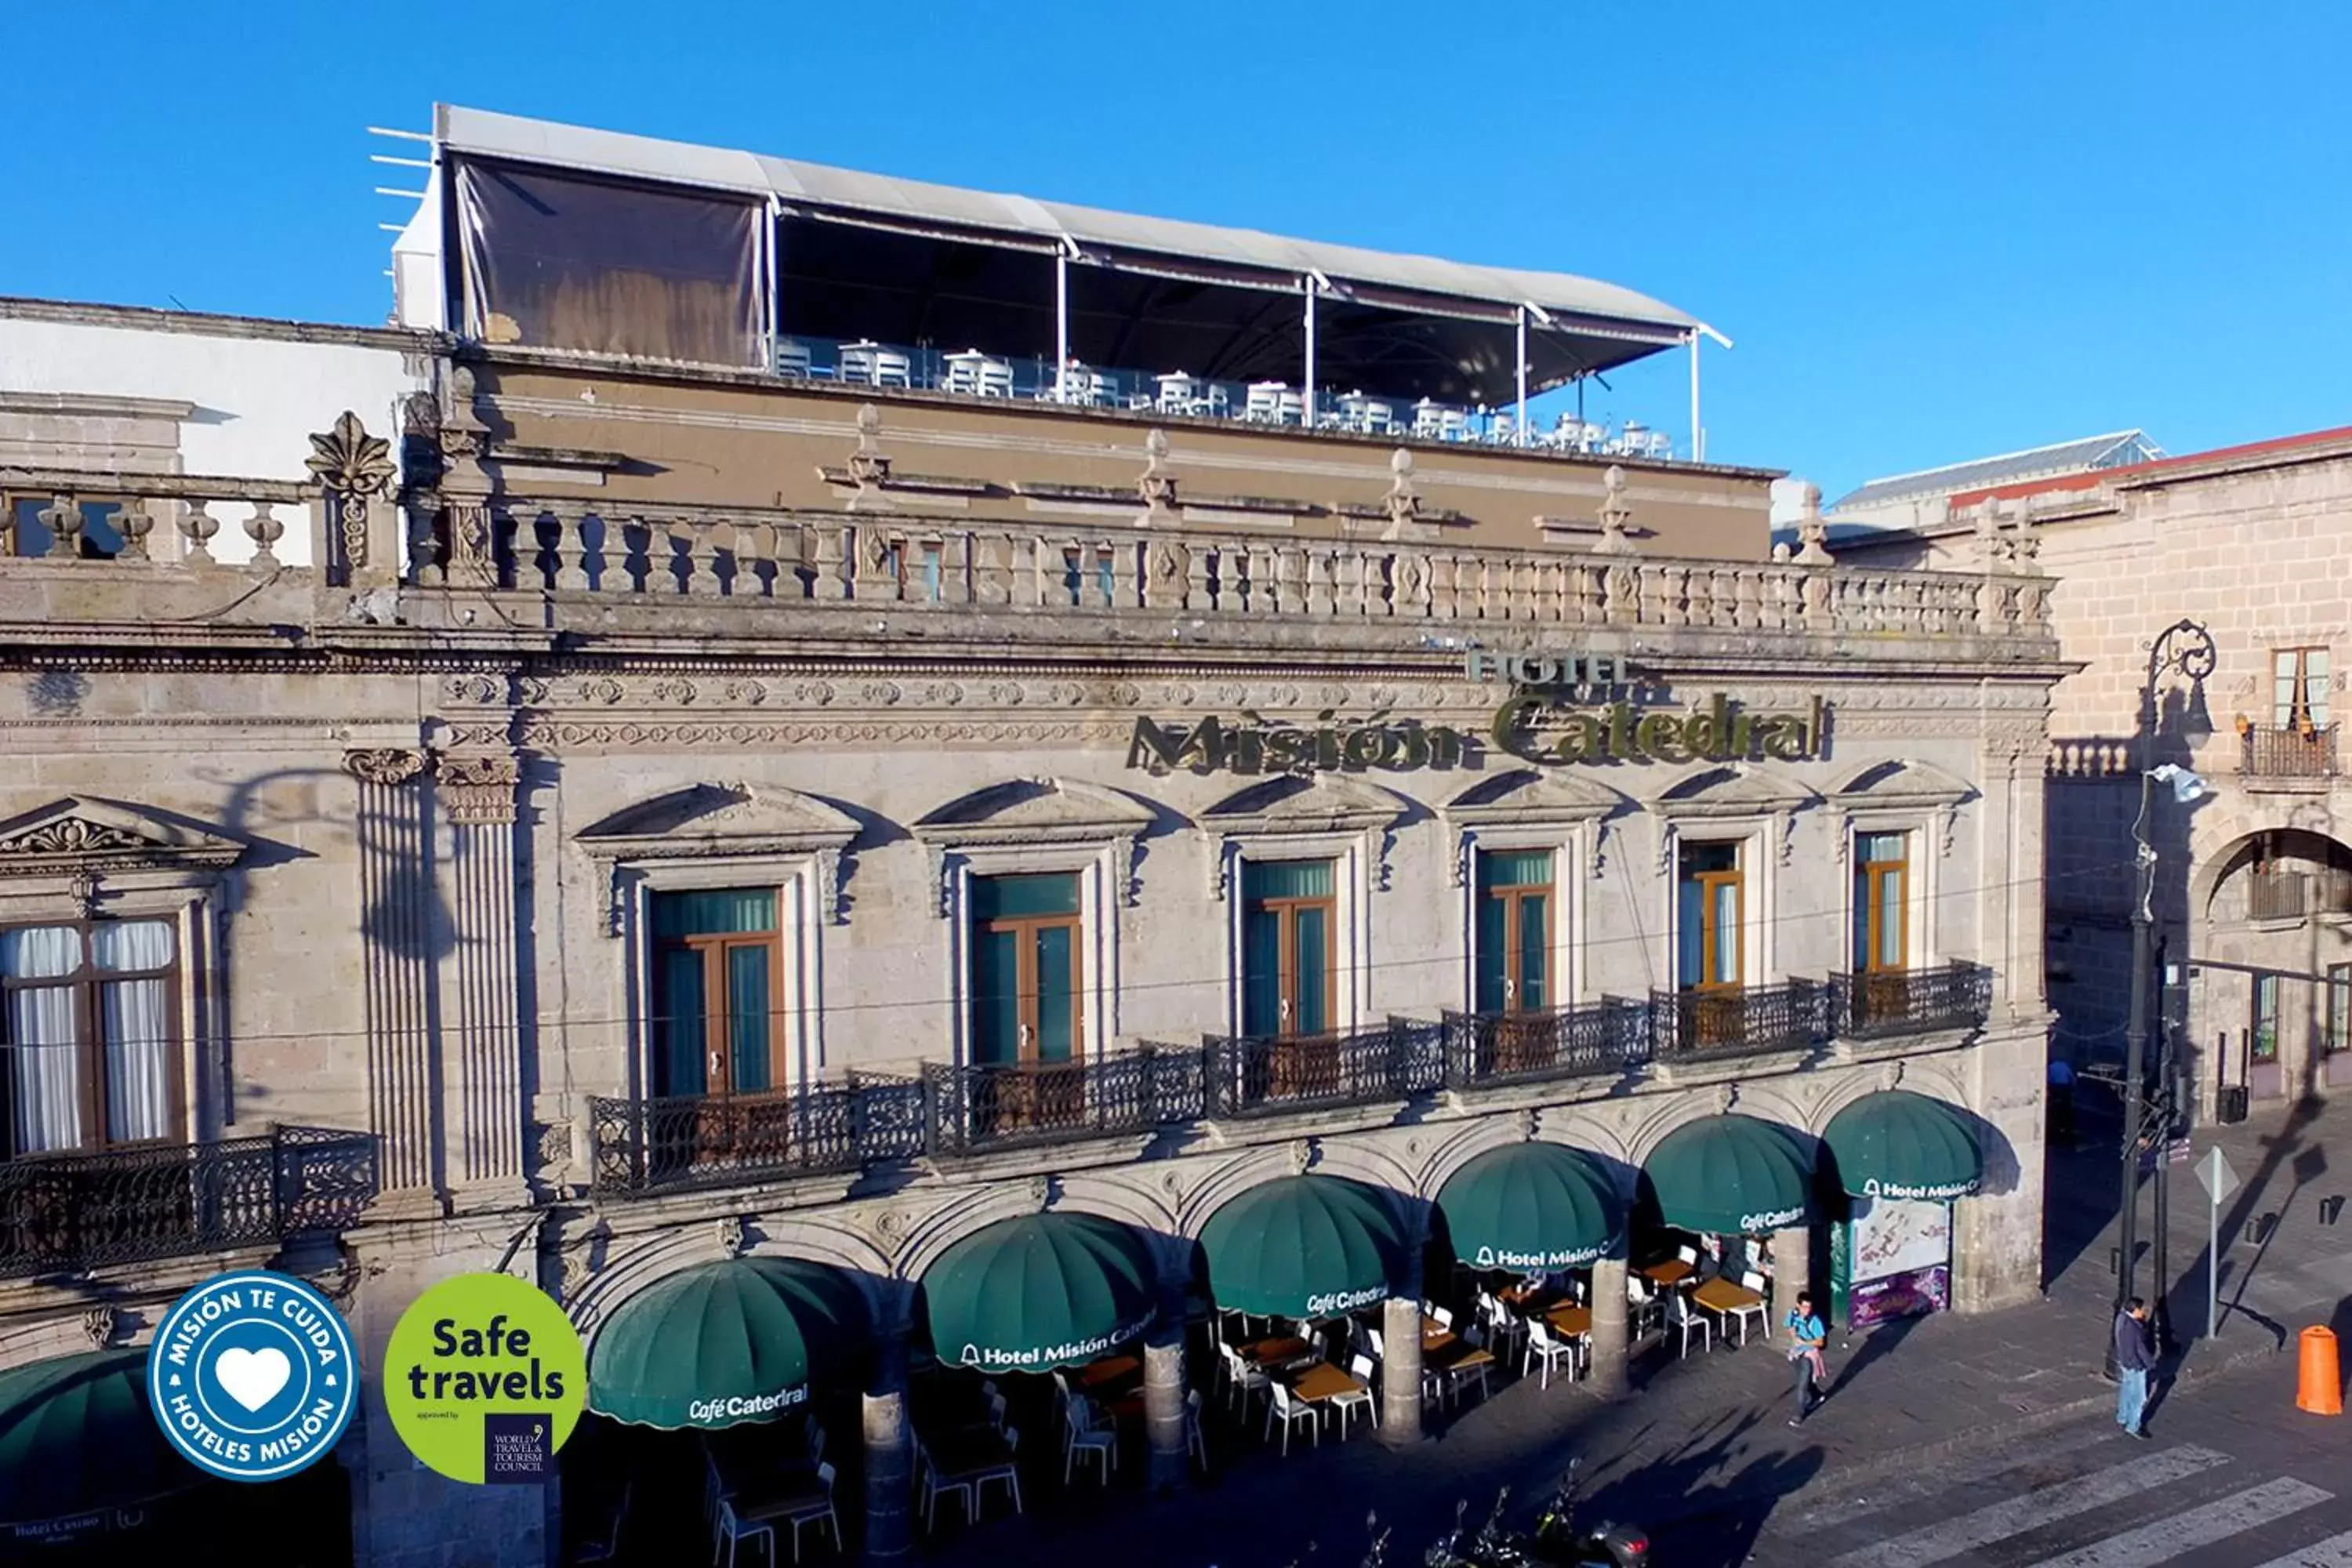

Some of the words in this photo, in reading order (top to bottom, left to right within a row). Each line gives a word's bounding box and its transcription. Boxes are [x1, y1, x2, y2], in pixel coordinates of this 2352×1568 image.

[1467, 652, 1635, 684] HOTEL
[1126, 709, 1461, 770] Misión
[1491, 693, 1821, 766] Catedral
[1882, 1182, 1926, 1198] Hotel
[1765, 1207, 1806, 1227] Catedr
[1497, 1250, 1545, 1266] Hotel
[1548, 1246, 1598, 1266] Misión
[1306, 1292, 1336, 1316] Café
[983, 1346, 1039, 1365] Hotel
[1044, 1337, 1108, 1363] Misión
[689, 1398, 726, 1424] Café
[726, 1383, 808, 1416] Catedral
